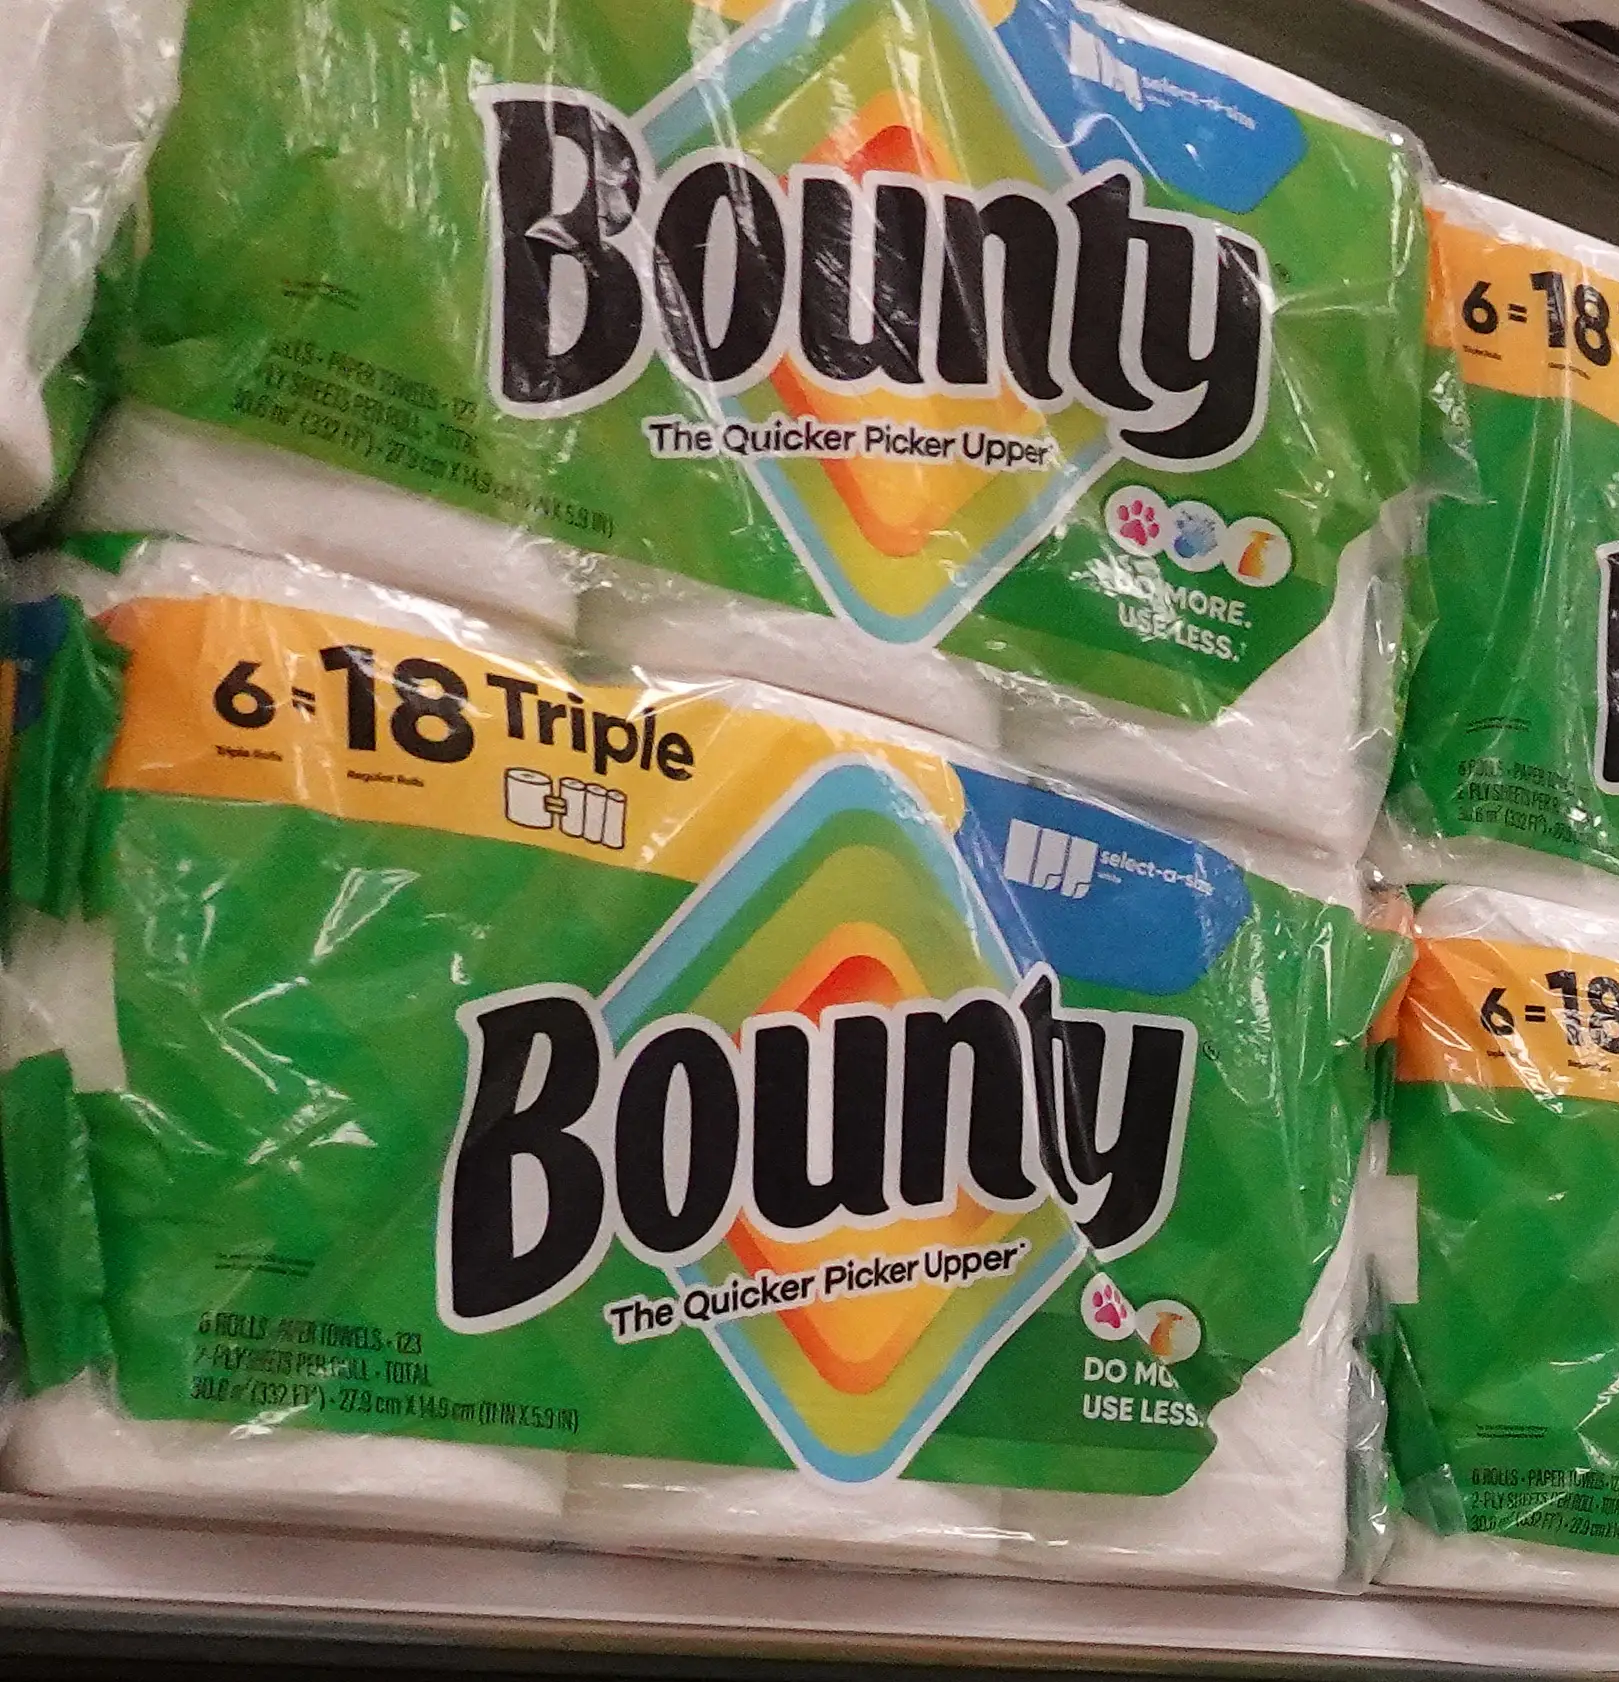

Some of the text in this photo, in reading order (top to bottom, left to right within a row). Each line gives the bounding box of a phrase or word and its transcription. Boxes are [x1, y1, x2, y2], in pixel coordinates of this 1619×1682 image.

[491, 98, 1263, 460] Bounty
[650, 422, 1048, 466] The Quicker Picker Upper
[1164, 590, 1251, 628] MORE.
[486, 674, 695, 781] Triple
[452, 975, 1185, 1318] Bounty
[611, 1243, 1017, 1337] The Quicker Picker Upper
[1084, 1357, 1129, 1385] DO
[1084, 1397, 1204, 1429] USE LESS.
